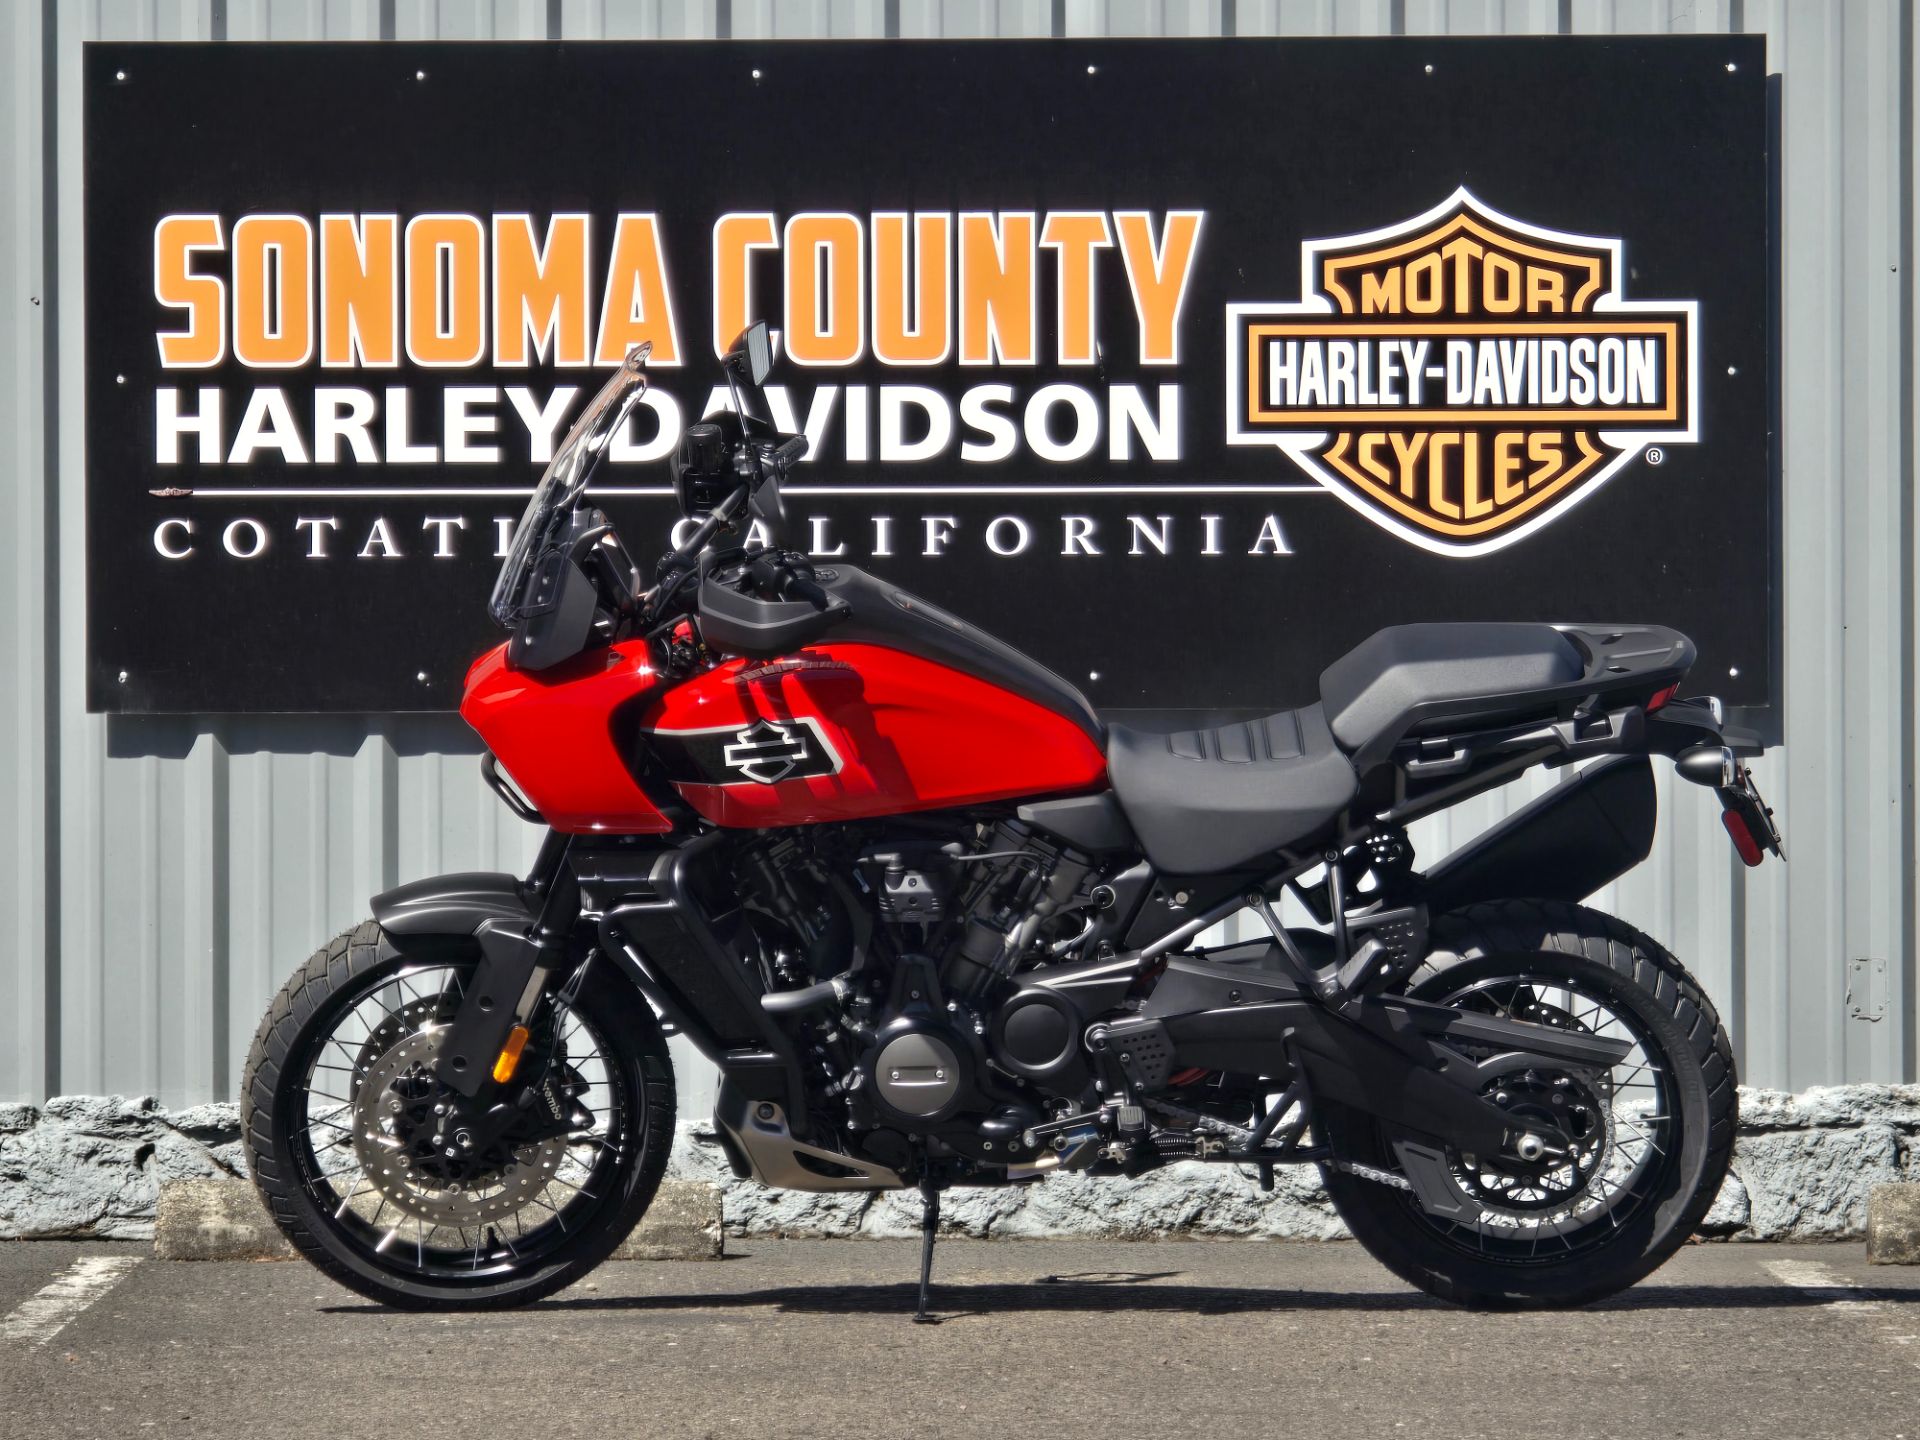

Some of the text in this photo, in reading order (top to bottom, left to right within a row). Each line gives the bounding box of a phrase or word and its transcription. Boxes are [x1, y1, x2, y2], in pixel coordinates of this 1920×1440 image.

[153, 209, 1206, 369] SONOMA COUNTY
[1361, 235, 1565, 314] MOTOR
[1269, 337, 1657, 406] HARLEY-DAVIDSON
[1358, 432, 1564, 521] CYCLES
[153, 514, 1294, 559] COTATI CALIFORNIA
